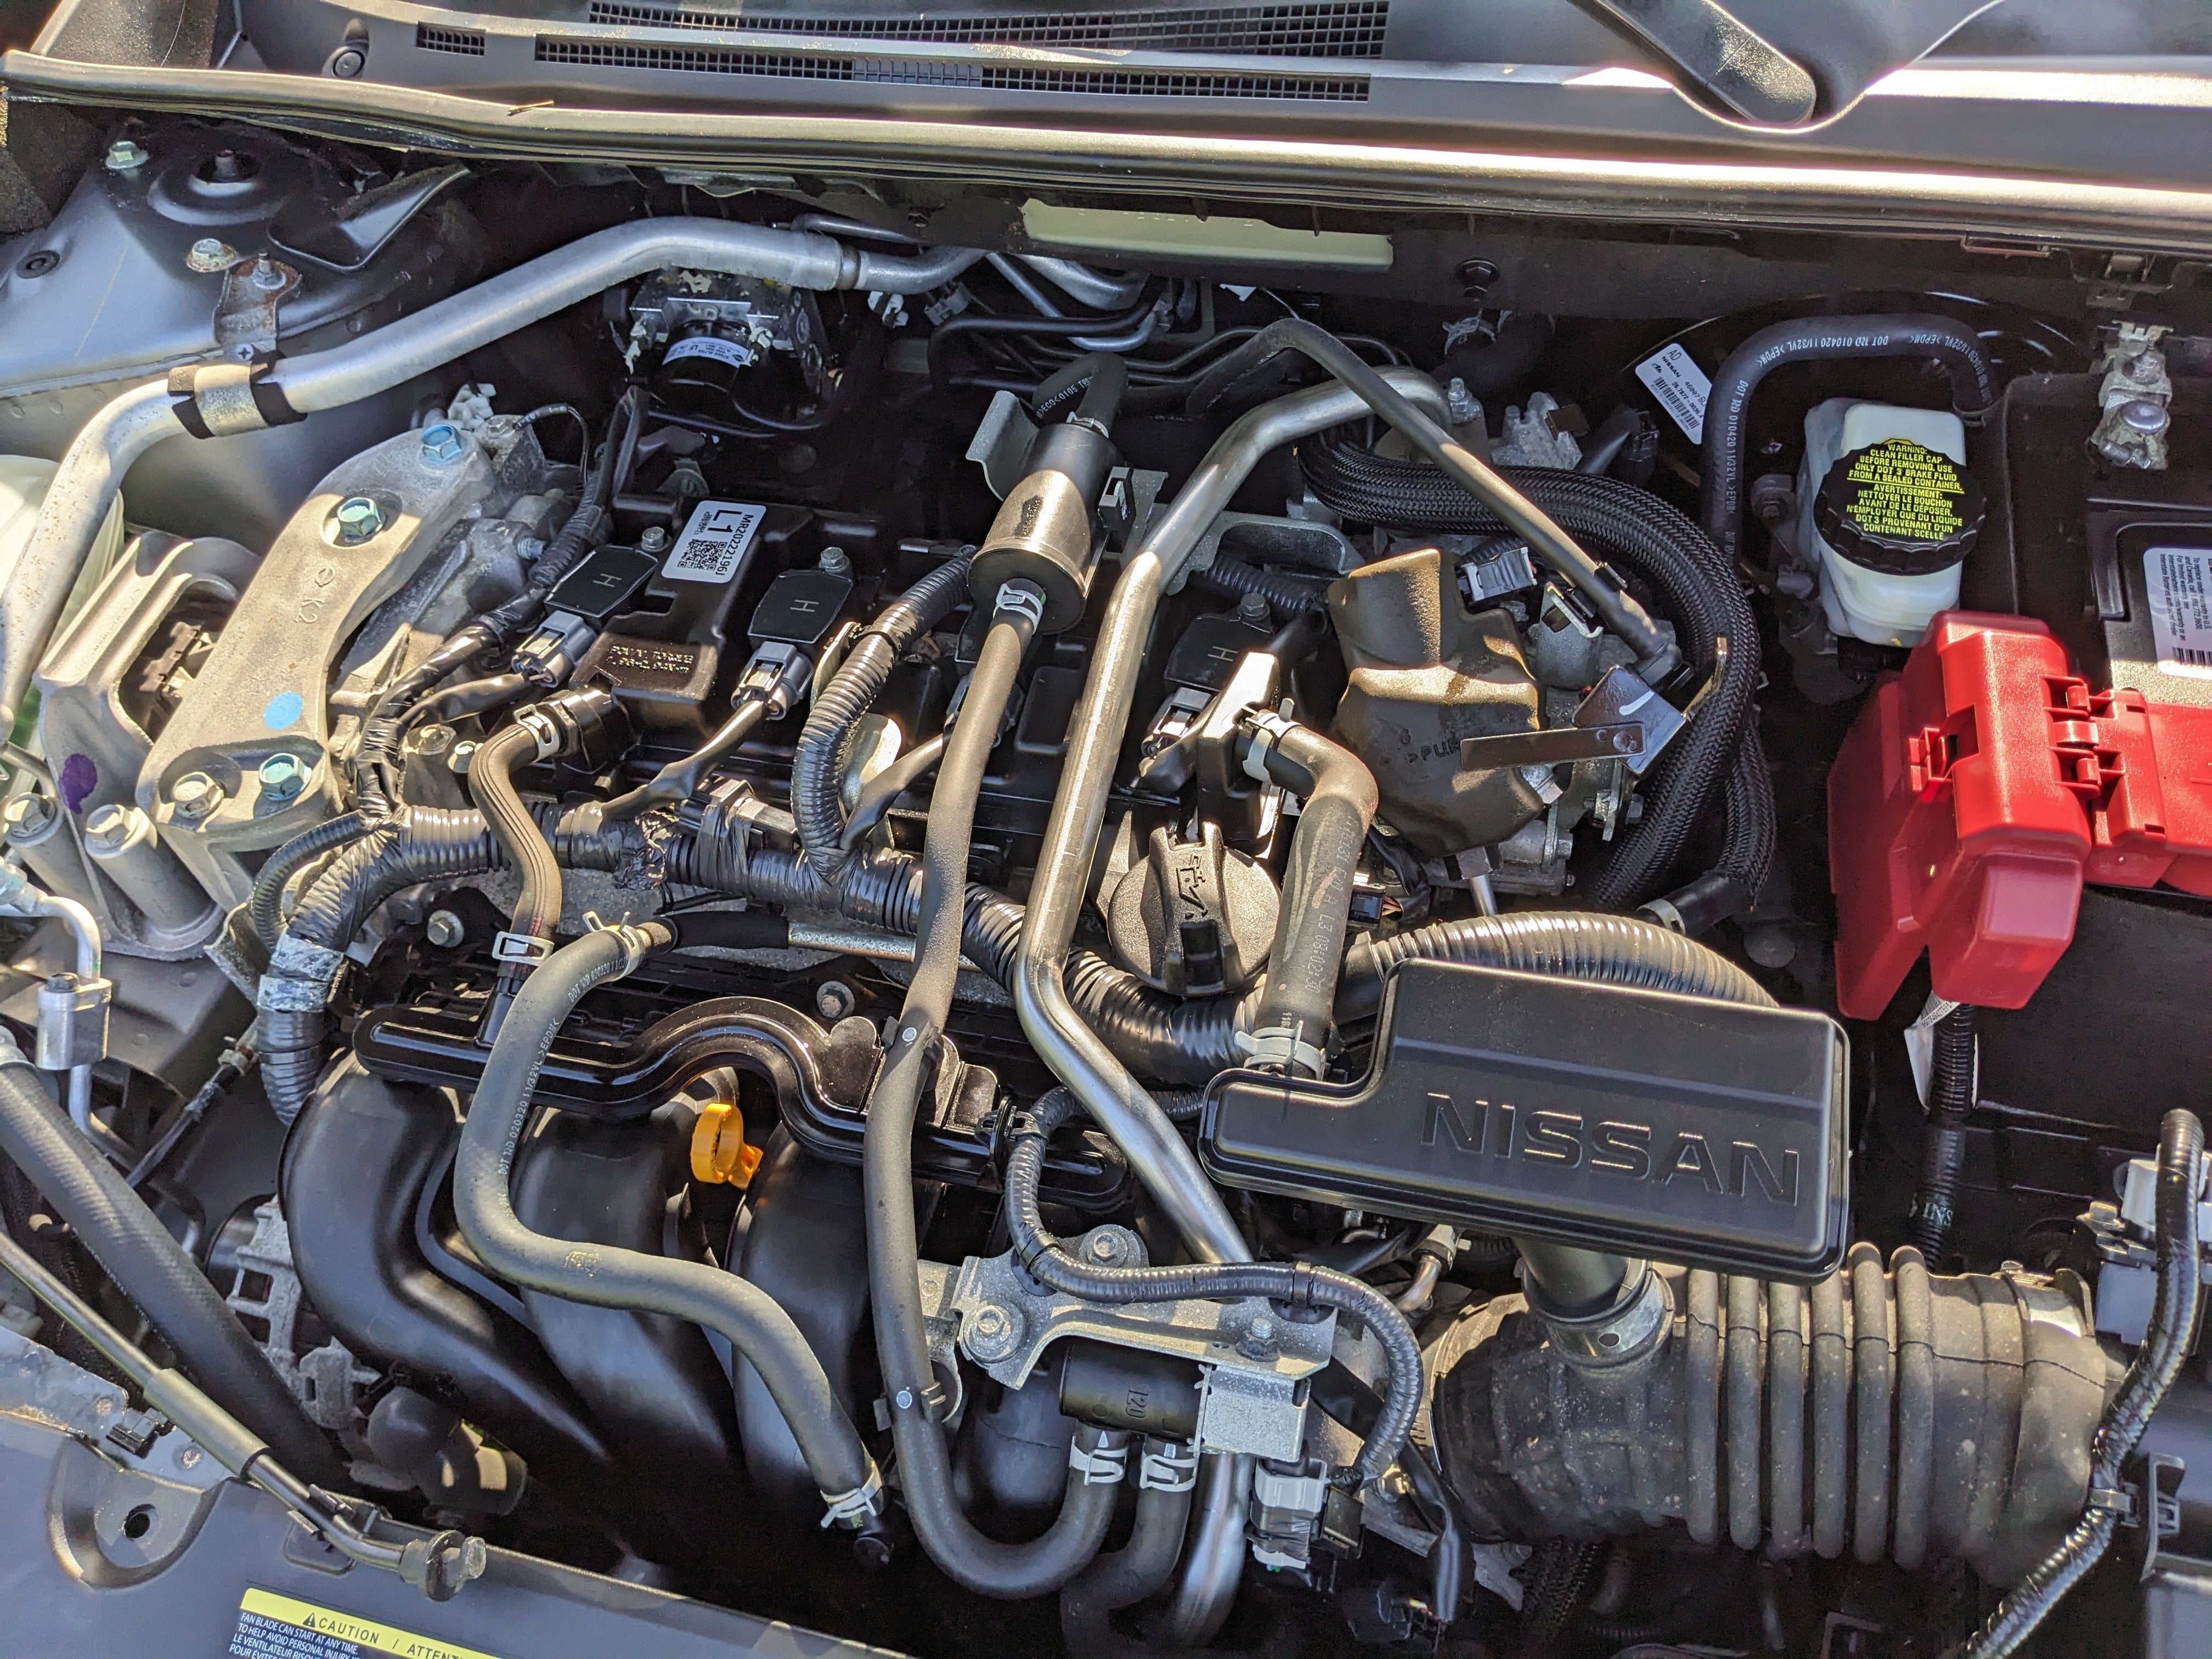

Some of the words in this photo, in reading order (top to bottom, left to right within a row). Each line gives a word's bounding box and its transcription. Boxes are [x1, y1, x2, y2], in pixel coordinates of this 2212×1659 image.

[1820, 337, 1853, 347] 010420
[1872, 336, 1889, 346] DOT
[1667, 349, 1682, 361] AD
[1661, 356, 1681, 378] NISSAN
[1736, 380, 1748, 398] DOT
[1727, 415, 1739, 447] 010420
[1870, 449, 1895, 459] CLEAN
[1898, 452, 1923, 462] FILLER
[1926, 455, 1943, 464] CAP
[1888, 444, 1927, 454] WARNING:
[1855, 463, 1875, 472] ONLY
[1877, 466, 1893, 475] DOT
[1905, 469, 1932, 478] BRAKE
[1934, 472, 1957, 481] FLUID
[1860, 455, 1889, 466] BEFORE
[1937, 465, 1953, 473] USE
[1849, 470, 1872, 479] FROM
[1882, 474, 1912, 484] SEALED
[1914, 478, 1962, 490] CONTAINER.
[1858, 490, 1900, 502] NETTOYER
[1914, 496, 1953, 508] BOUCHON
[1874, 484, 1943, 499] AVERTISSEMENT:
[1859, 498, 1887, 509] AVANT
[1889, 501, 1900, 510] DE
[1901, 503, 1911, 511] LE
[707, 509, 743, 534] L1
[1847, 505, 1897, 517] N'EMPLOYER
[1899, 510, 1916, 520] QUE
[1918, 513, 1929, 521] DU
[1931, 515, 1962, 526] LIQUIDE
[1856, 514, 1872, 523] DOT
[1882, 518, 1932, 531] PROVENANT
[1934, 524, 1953, 533] D'UN
[1864, 523, 1912, 537] CONTENANT
[714, 514, 755, 576] MR20222196J
[510, 1101, 528, 1139] 020320
[1419, 1090, 1799, 1206] NISSAN
[238, 1623, 250, 1633] TO
[248, 1626, 267, 1637] HELP
[266, 1632, 289, 1646] AVOID
[288, 1638, 324, 1656] PERSONAL
[240, 1612, 256, 1622] FAN
[255, 1616, 279, 1630] BLADE
[278, 1623, 296, 1636] CAN
[295, 1628, 317, 1642] START
[315, 1635, 327, 1644] AT
[324, 1637, 343, 1649] ANY
[319, 1617, 380, 1644] CAUTION
[407, 1643, 464, 1659] ATTEN
[229, 1643, 252, 1657] POUR
[233, 1633, 244, 1643] LE
[244, 1635, 292, 1658] VENTILATEUR
